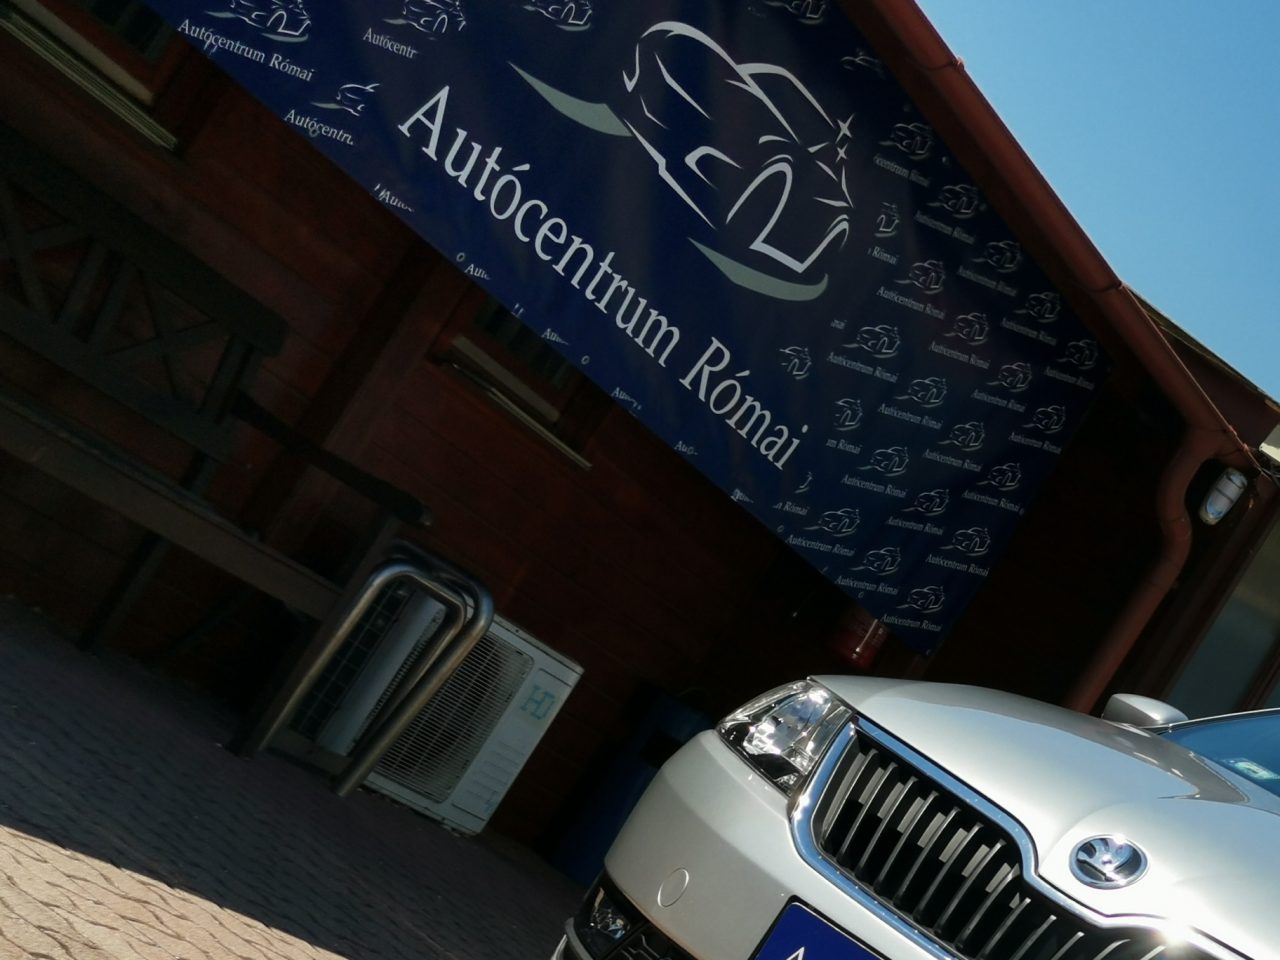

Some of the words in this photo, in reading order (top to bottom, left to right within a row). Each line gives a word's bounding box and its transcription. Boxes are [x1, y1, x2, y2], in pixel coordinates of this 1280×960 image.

[177, 18, 266, 63] Autócentrum
[269, 53, 316, 82] Római
[363, 27, 420, 59] Autócentr
[397, 84, 681, 368] Autócentrum
[679, 335, 810, 471] Római
